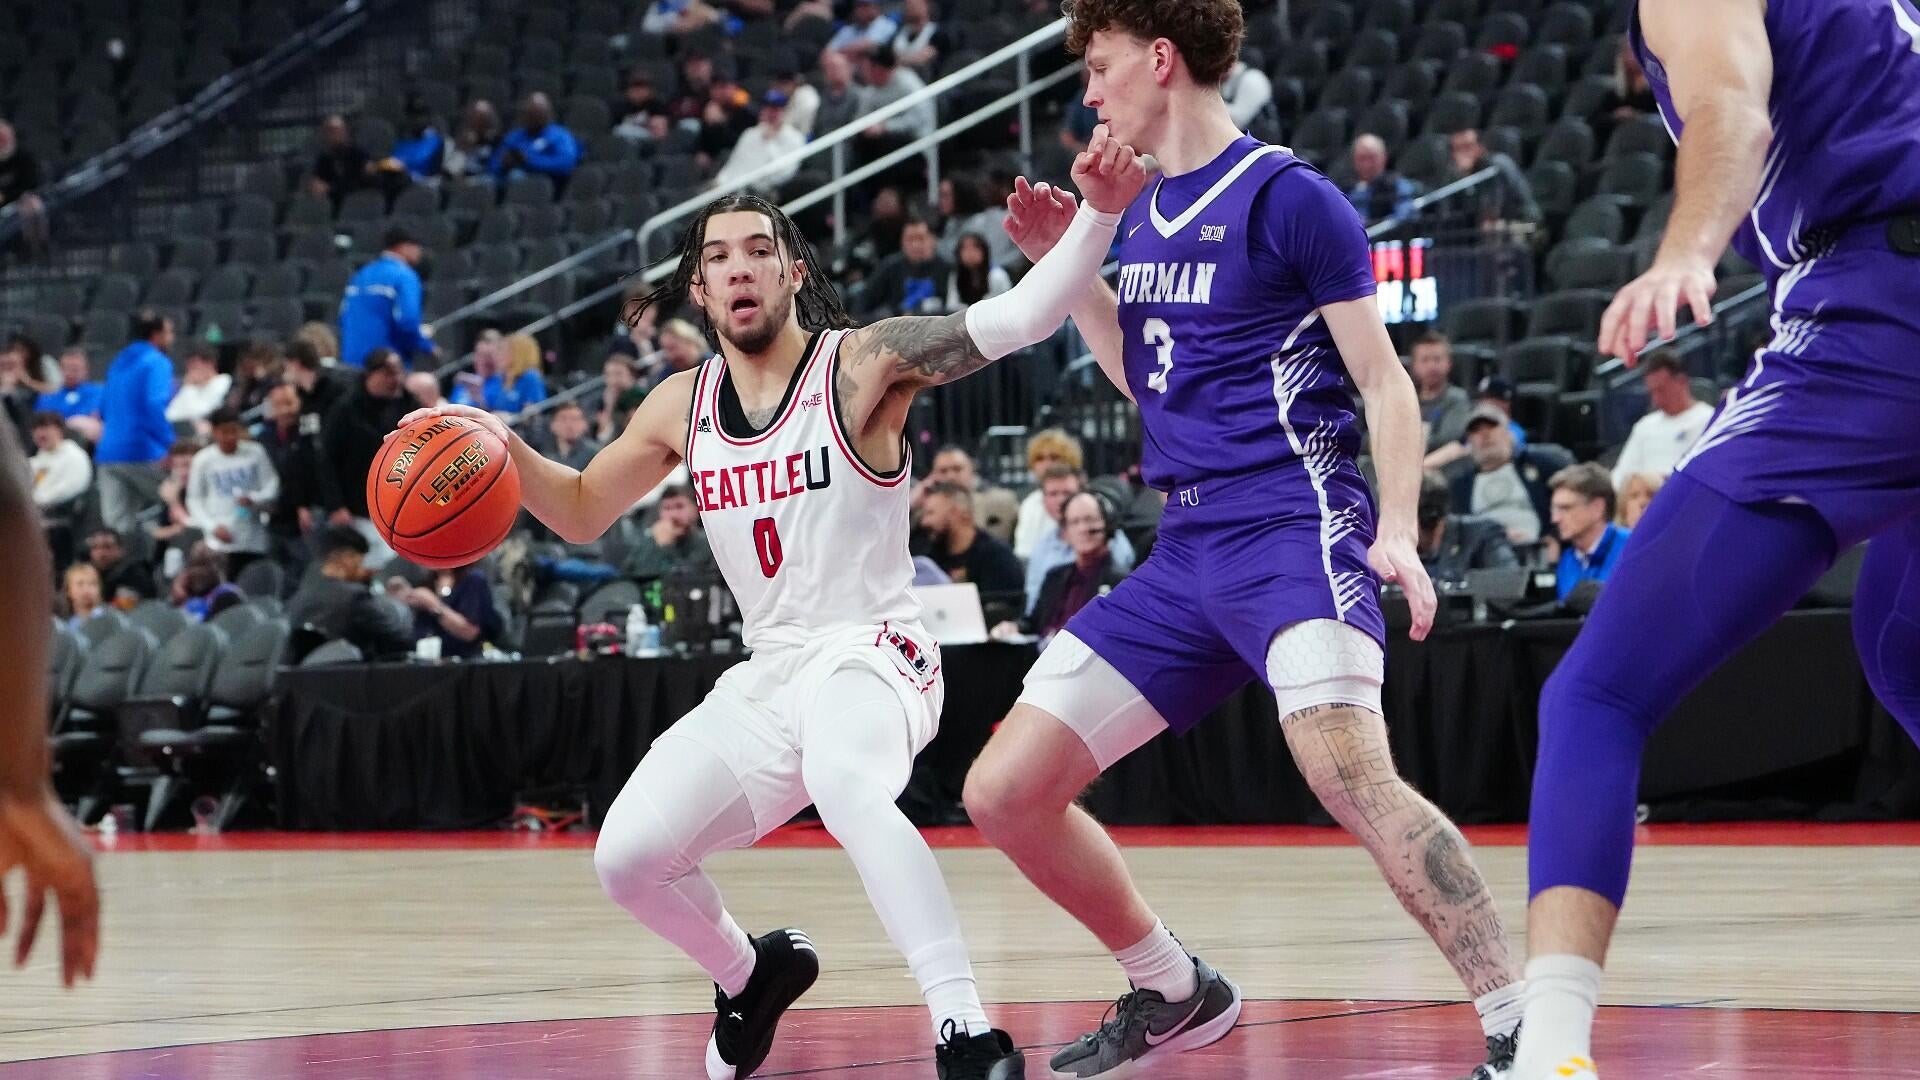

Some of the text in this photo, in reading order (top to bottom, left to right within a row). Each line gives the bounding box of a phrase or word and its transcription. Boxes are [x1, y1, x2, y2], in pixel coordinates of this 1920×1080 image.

[1199, 224, 1227, 242] SOCON
[1118, 262, 1217, 305] FURMAN
[1142, 317, 1175, 394] 3
[419, 439, 485, 505] LEGACY
[1178, 486, 1199, 507] FU
[752, 516, 784, 579] 0
